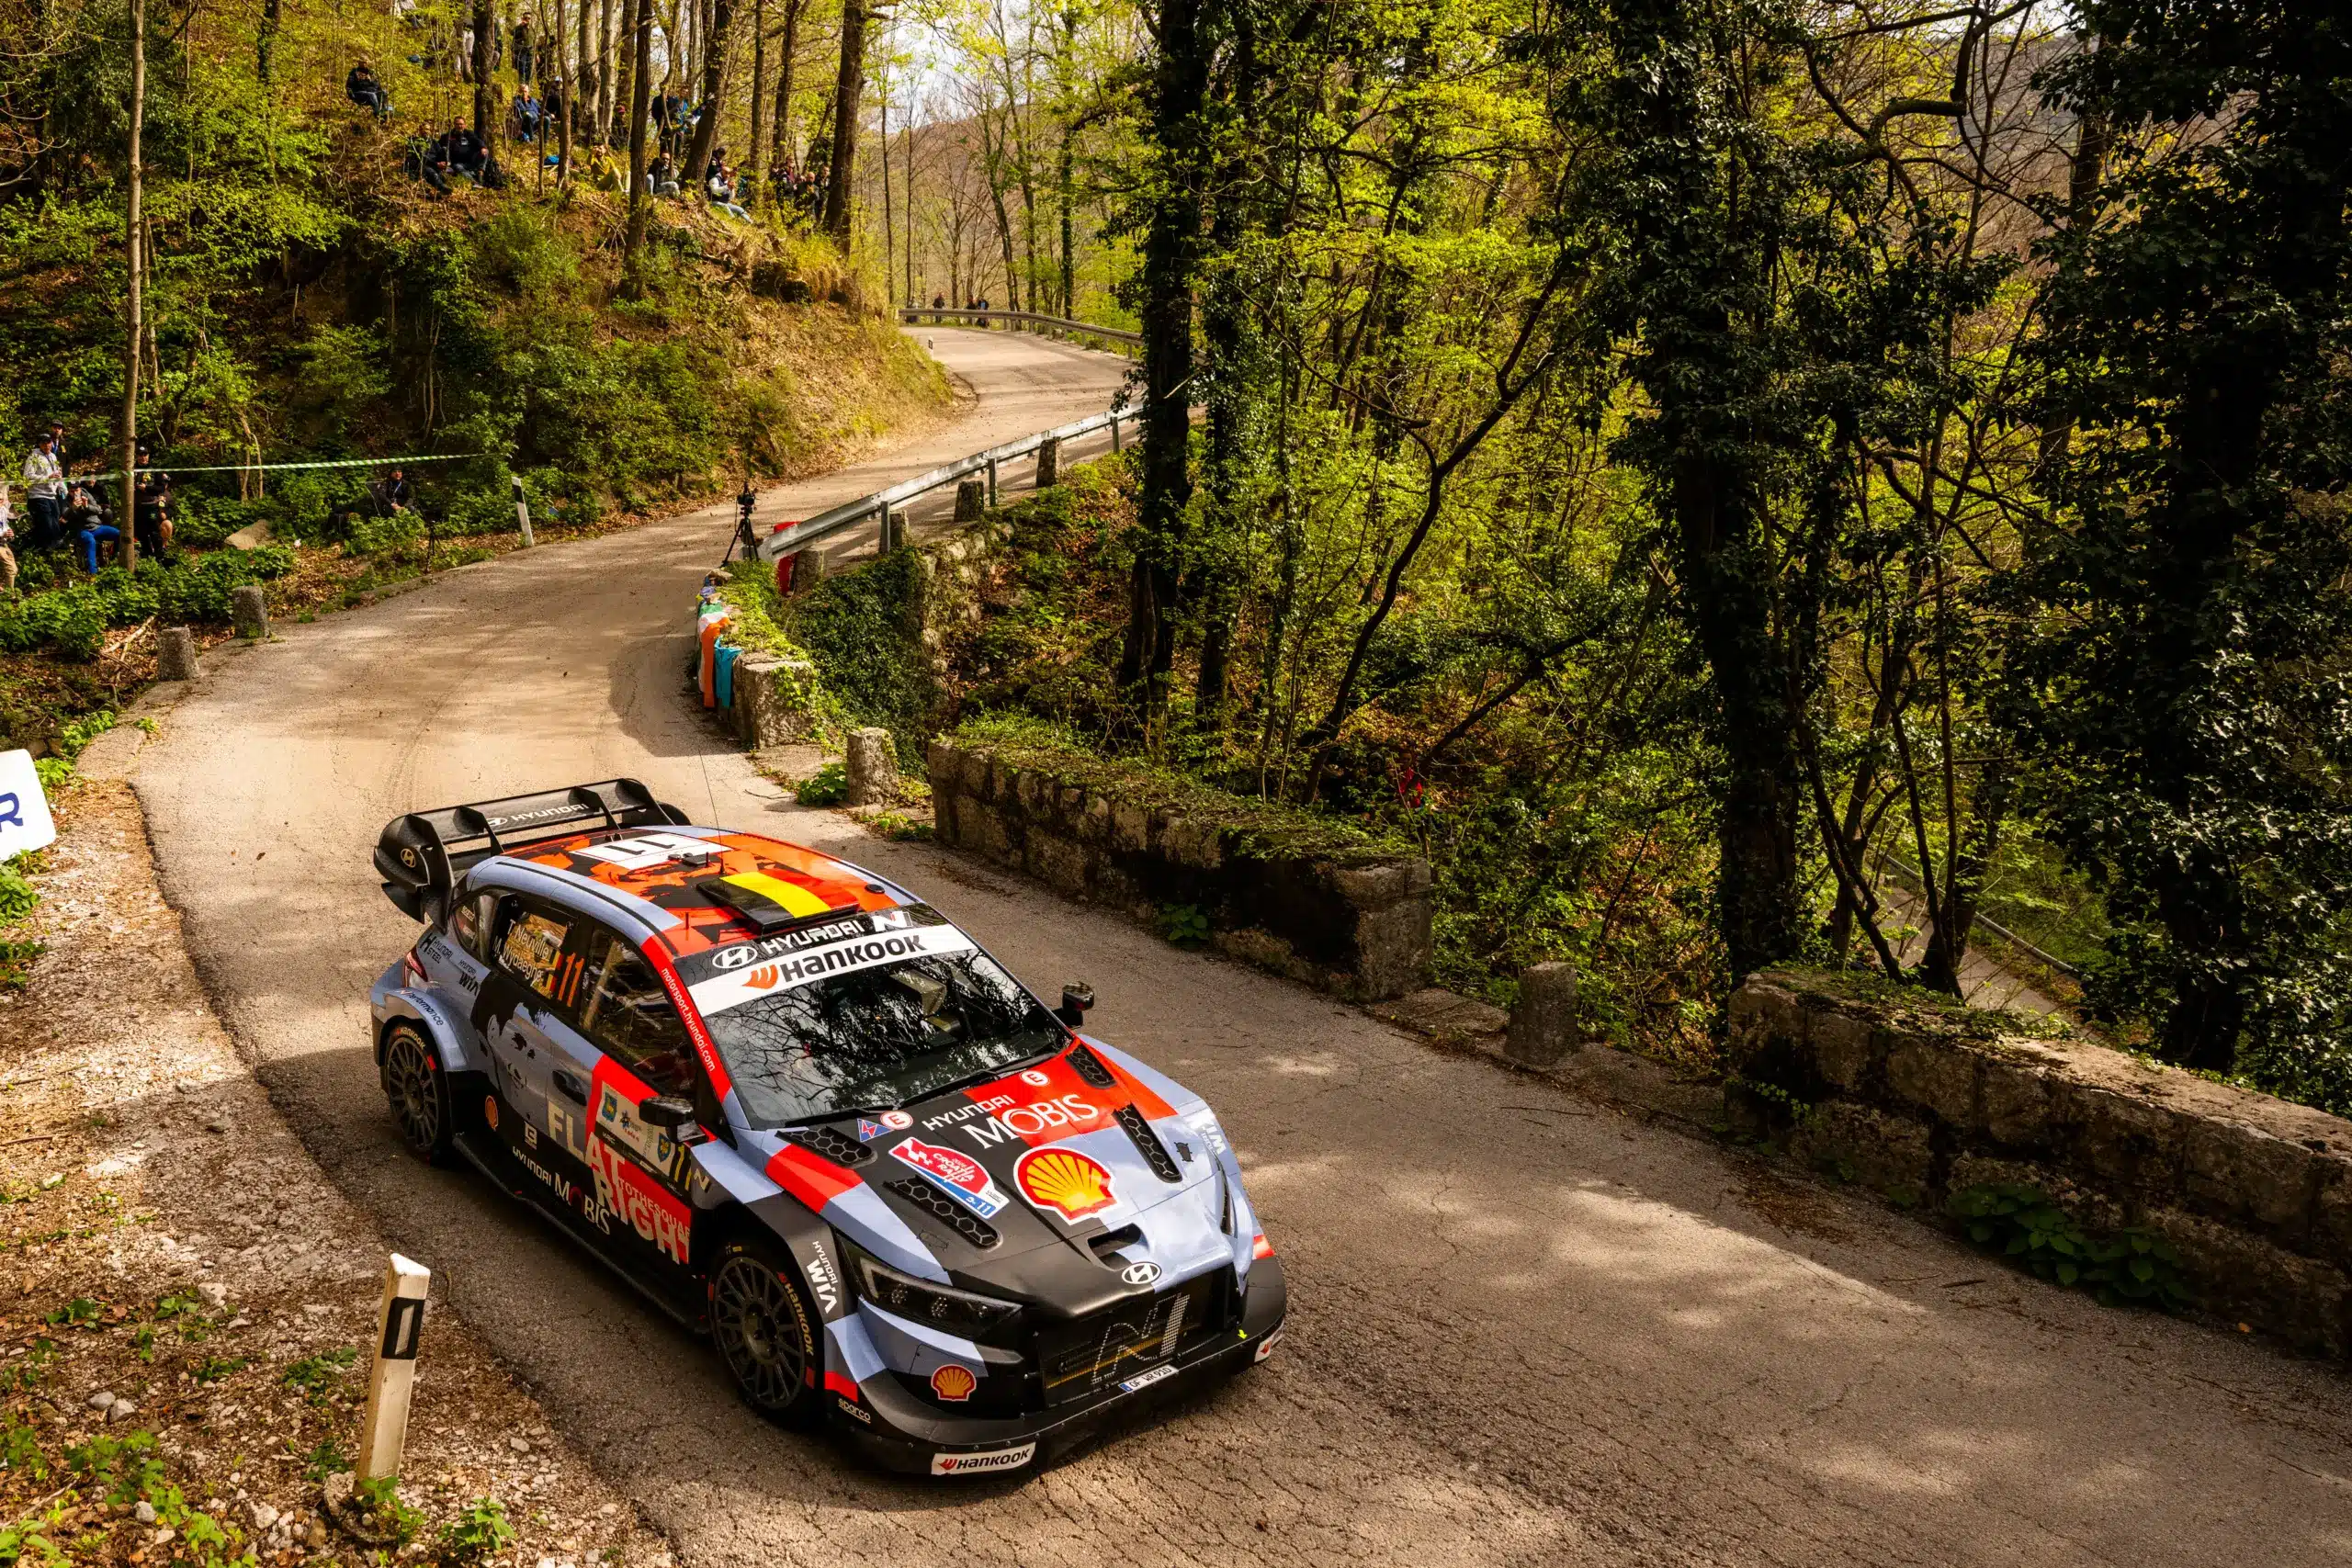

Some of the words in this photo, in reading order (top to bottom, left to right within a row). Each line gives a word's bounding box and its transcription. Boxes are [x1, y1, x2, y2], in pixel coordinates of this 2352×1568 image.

[511, 802, 589, 822] HYUNDAI
[605, 839, 675, 855] 11
[426, 947, 442, 964] STEEL
[432, 940, 453, 960] HYUNDAI
[760, 919, 865, 955] HYUNDAI
[781, 935, 927, 983] HANKOOK
[558, 952, 584, 1008] 11
[662, 967, 716, 1072] motorsport.hyundai.com
[922, 1094, 1016, 1132] HYUNDAI
[960, 1094, 1099, 1149] MOBIS
[548, 1100, 626, 1185] FLAT
[933, 1153, 976, 1182] CROATIA
[937, 1164, 970, 1183] RALLY
[555, 1172, 610, 1235] MOBIS
[977, 1201, 991, 1214] 11
[812, 1240, 838, 1285] HYUNDAI
[806, 1258, 838, 1314] WIA
[784, 1282, 814, 1358] HANKOOK
[838, 1397, 871, 1423] sparco
[956, 1448, 1030, 1470] HANKOOK
